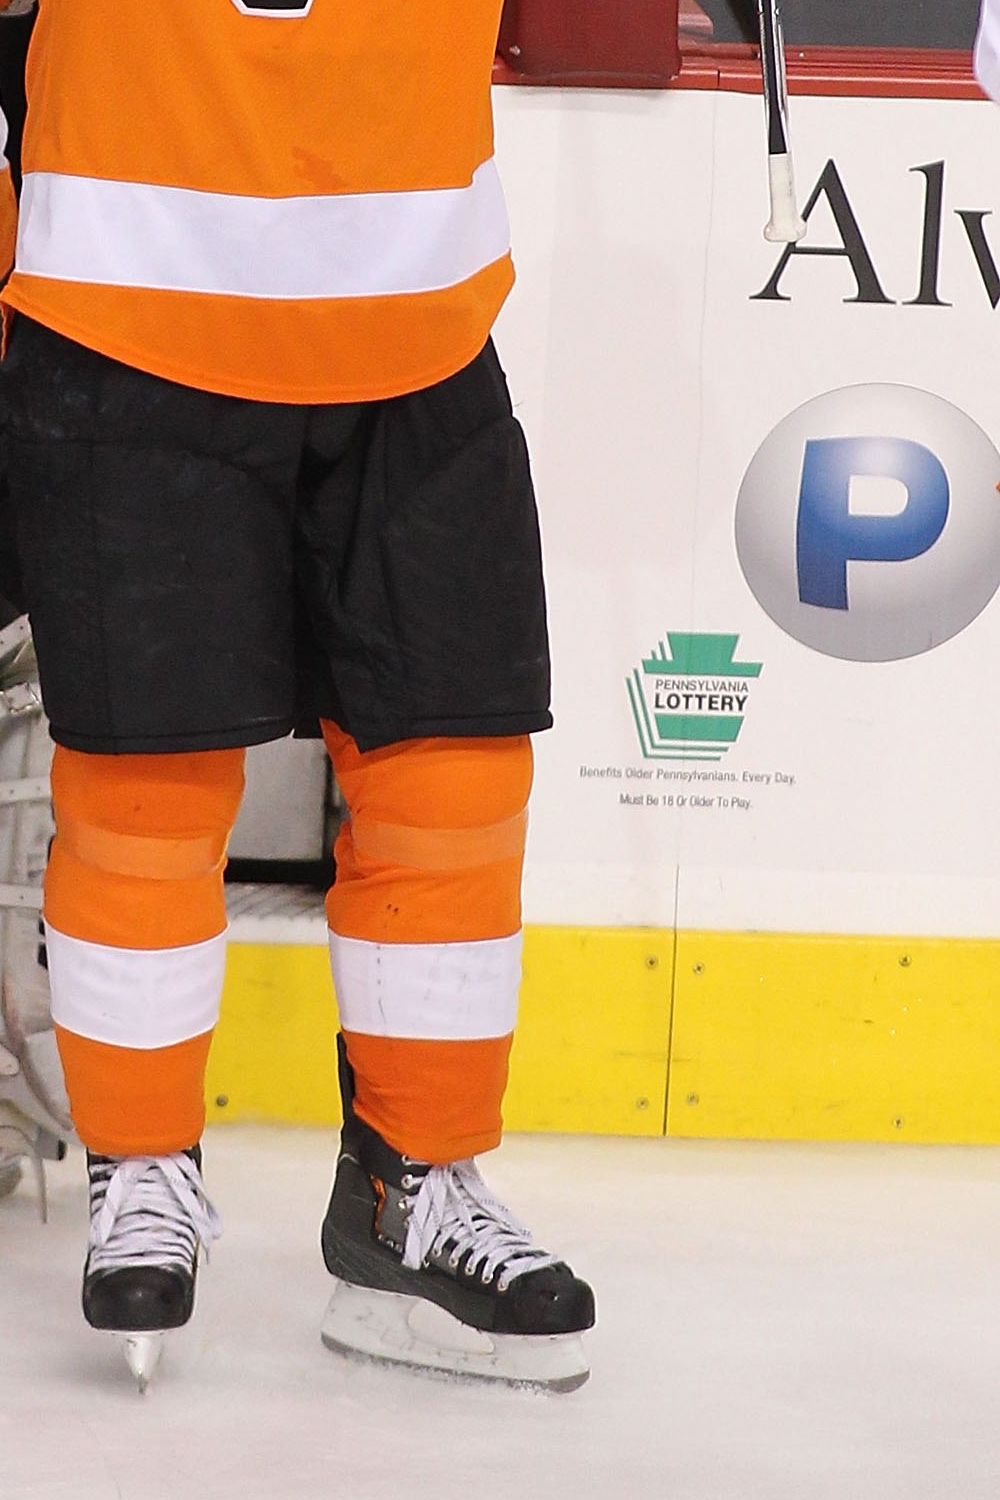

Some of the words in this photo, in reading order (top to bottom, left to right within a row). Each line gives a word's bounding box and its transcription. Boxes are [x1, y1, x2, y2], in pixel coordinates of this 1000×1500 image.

[655, 679, 749, 693] PENNSYLVANIA
[654, 693, 749, 712] LOTTERY
[579, 766, 622, 779] Benefits
[625, 767, 653, 780] Older
[742, 771, 771, 785] Every
[619, 793, 644, 805] Must
[646, 794, 659, 806] Be
[690, 795, 714, 807] Older
[716, 795, 729, 807] To
